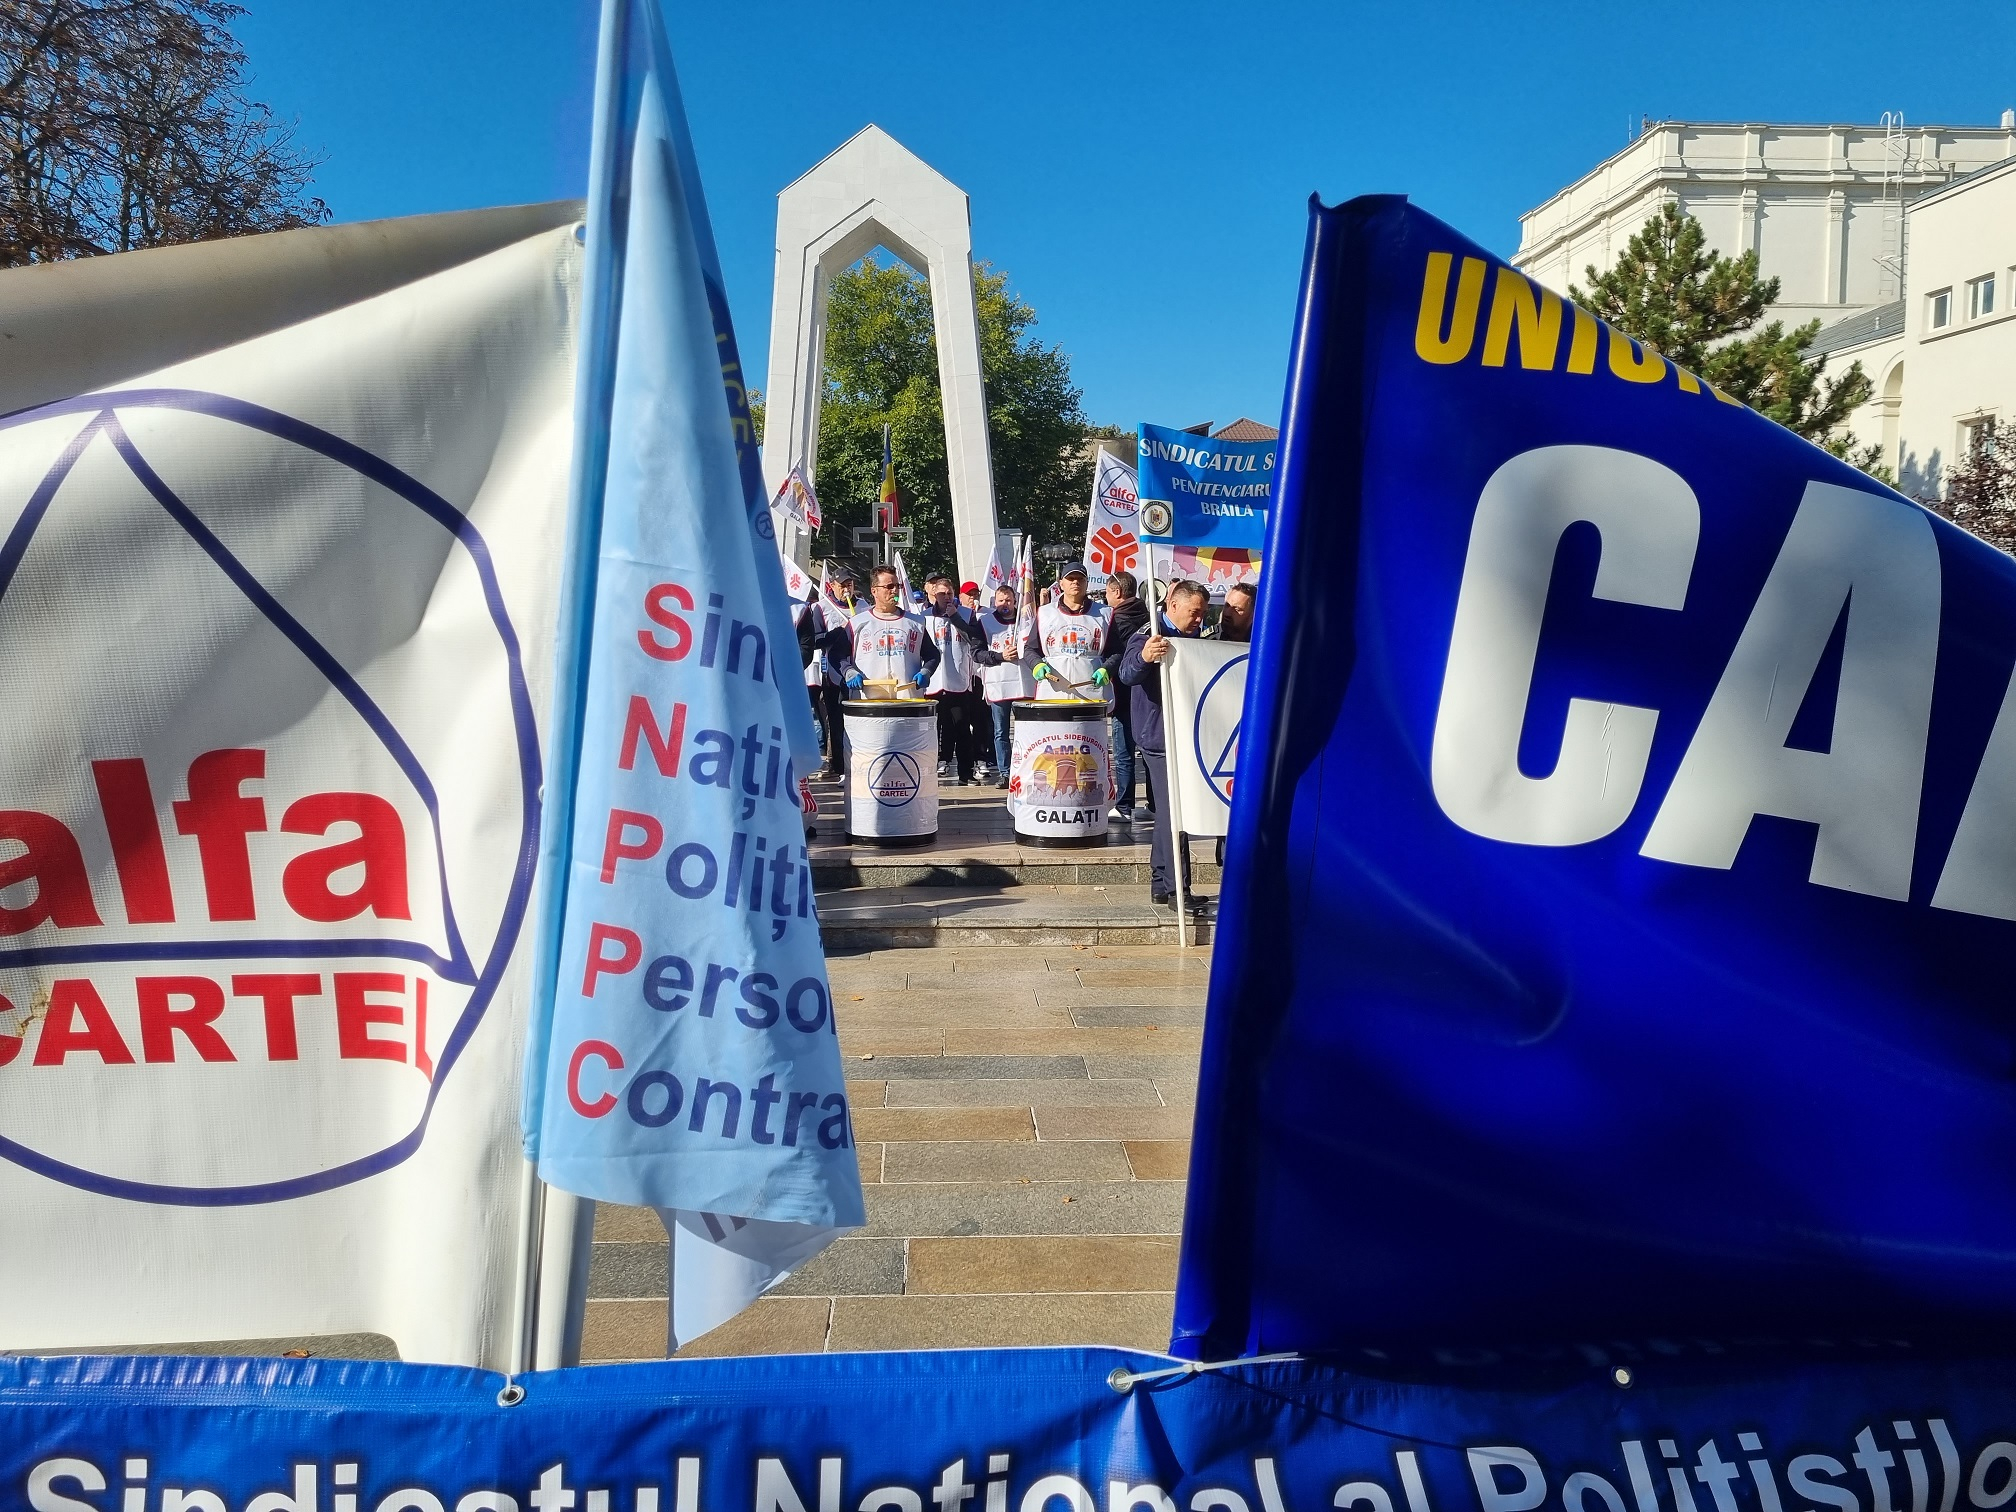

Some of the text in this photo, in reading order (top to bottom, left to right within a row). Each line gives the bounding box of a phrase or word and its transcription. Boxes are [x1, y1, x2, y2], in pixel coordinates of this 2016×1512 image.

[1414, 251, 1745, 409] UNIO
[1103, 499, 1136, 512] CARTEL
[1109, 487, 1136, 503] alfa
[1139, 438, 1277, 473] SINDICATUL S
[1201, 500, 1254, 517] BRĂILA
[638, 583, 781, 690] Sin
[1431, 445, 2016, 922] CA
[1023, 734, 1062, 760] SINDICATUL
[0, 748, 413, 937] alfa
[1035, 809, 1099, 828] GALAȚI
[599, 807, 822, 942] Poliți
[0, 972, 433, 1084] ARTEL
[581, 921, 837, 1036] Perso
[566, 1039, 857, 1151] Contra
